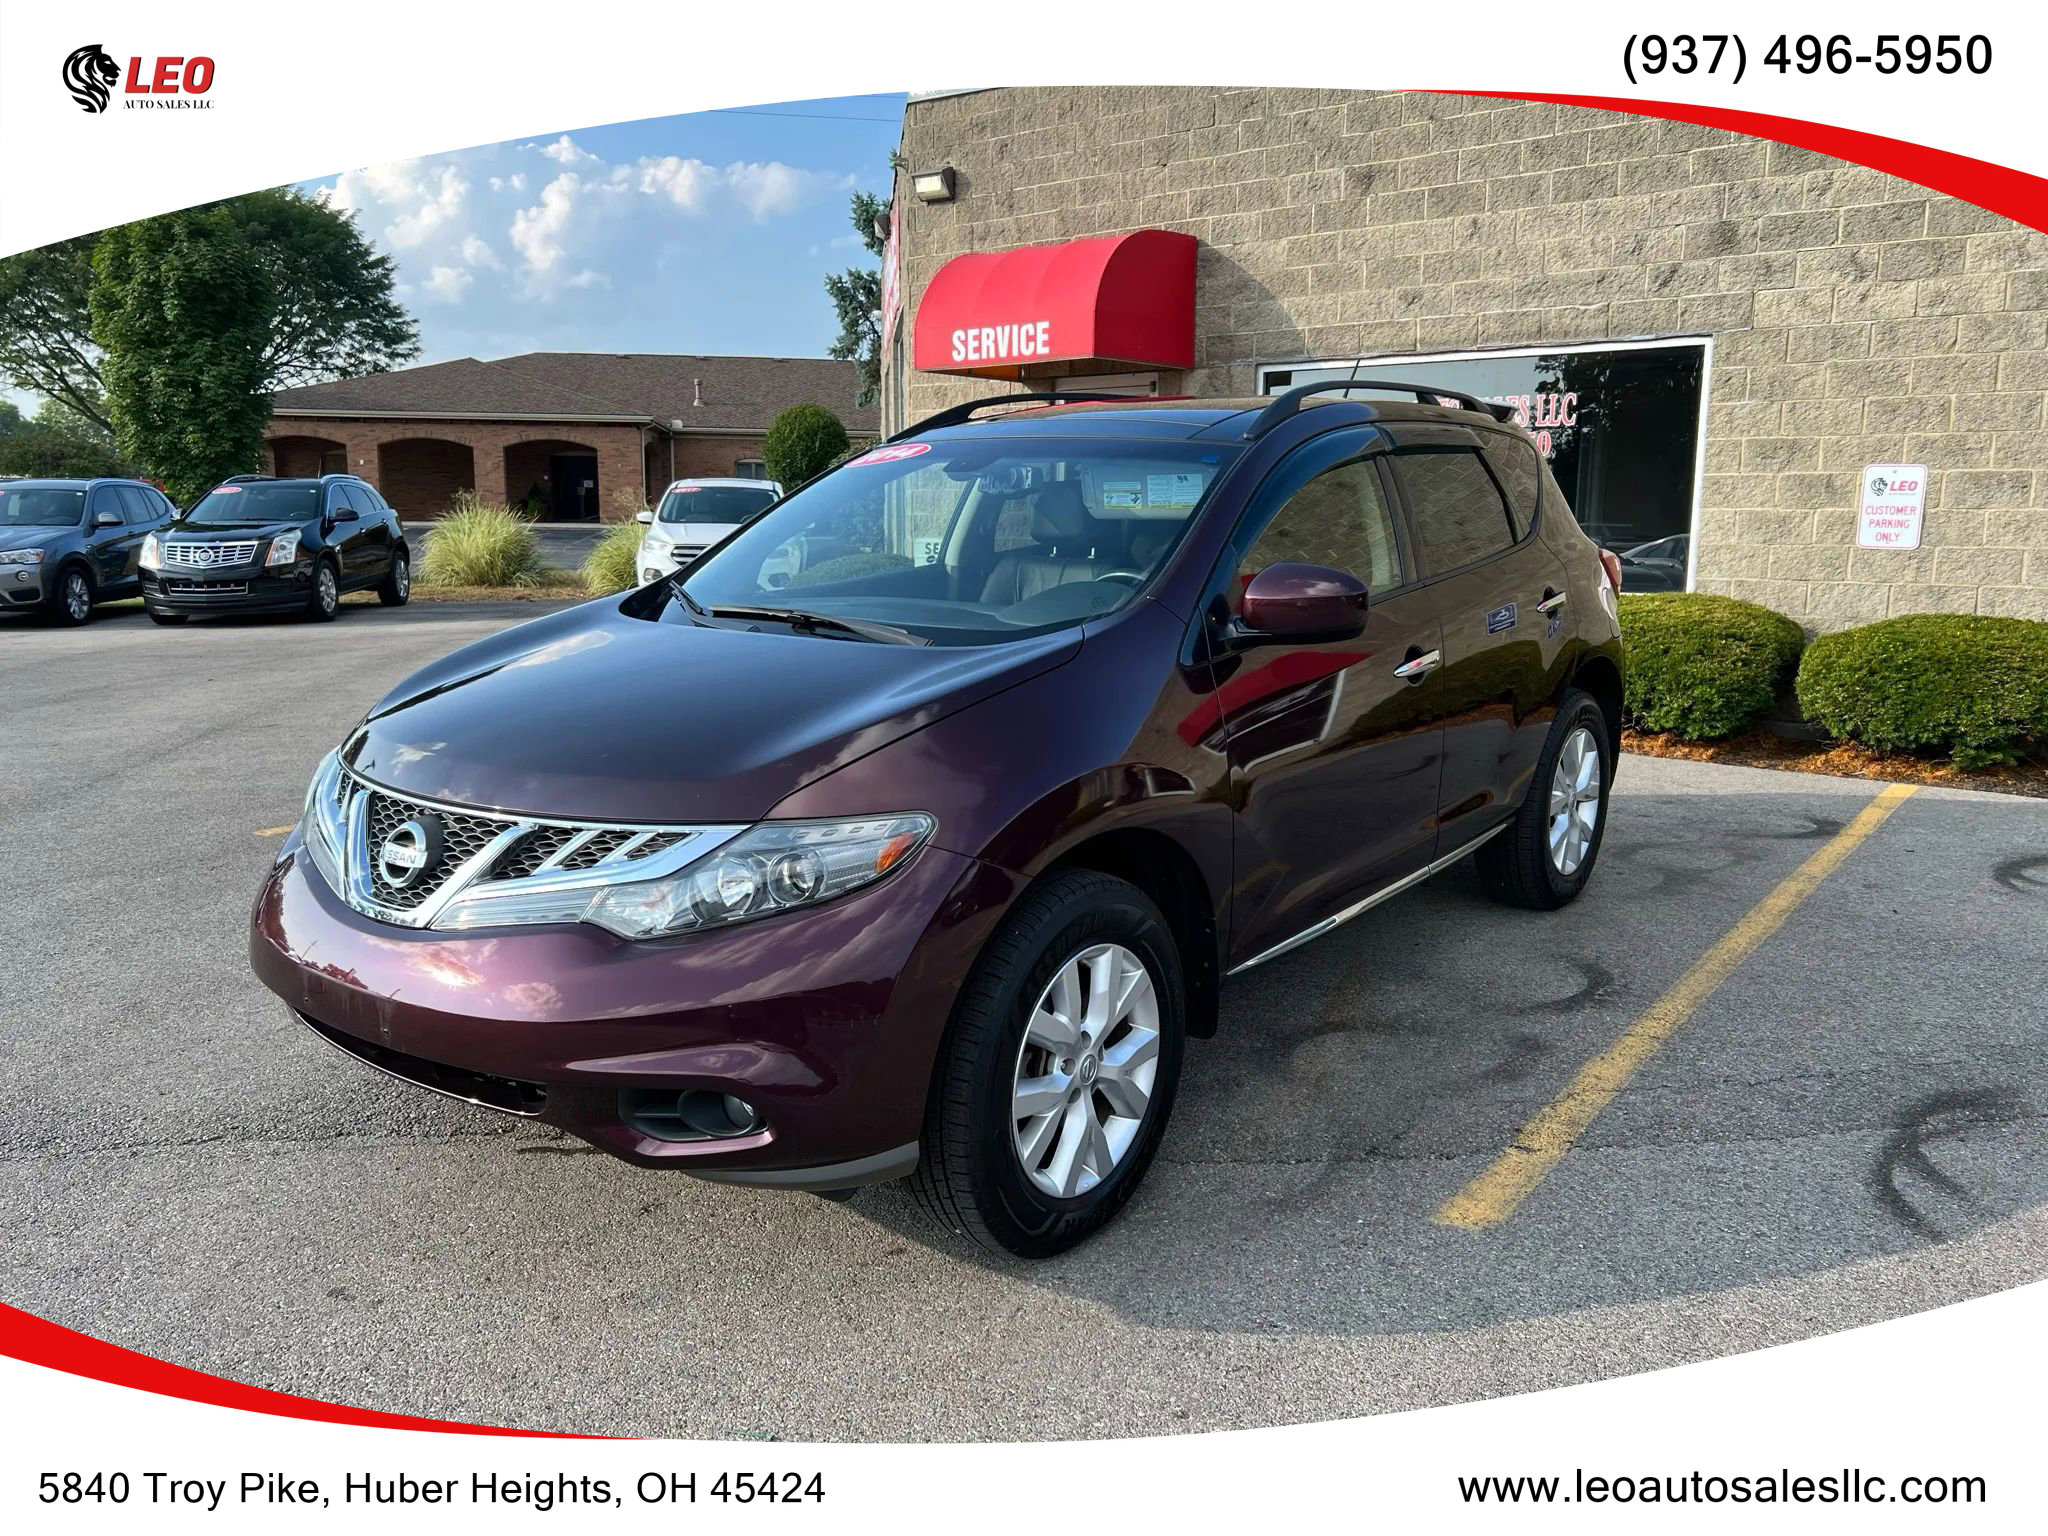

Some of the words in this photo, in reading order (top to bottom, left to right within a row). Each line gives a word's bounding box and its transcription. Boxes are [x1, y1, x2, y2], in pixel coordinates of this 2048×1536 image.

[952, 321, 1050, 362] SERVICE
[1536, 392, 1577, 427] LLC
[1889, 480, 1918, 491] LEO
[1865, 505, 1917, 516] CUSTOMER
[1869, 519, 1910, 529] PARKING
[1875, 532, 1900, 542] ONLY
